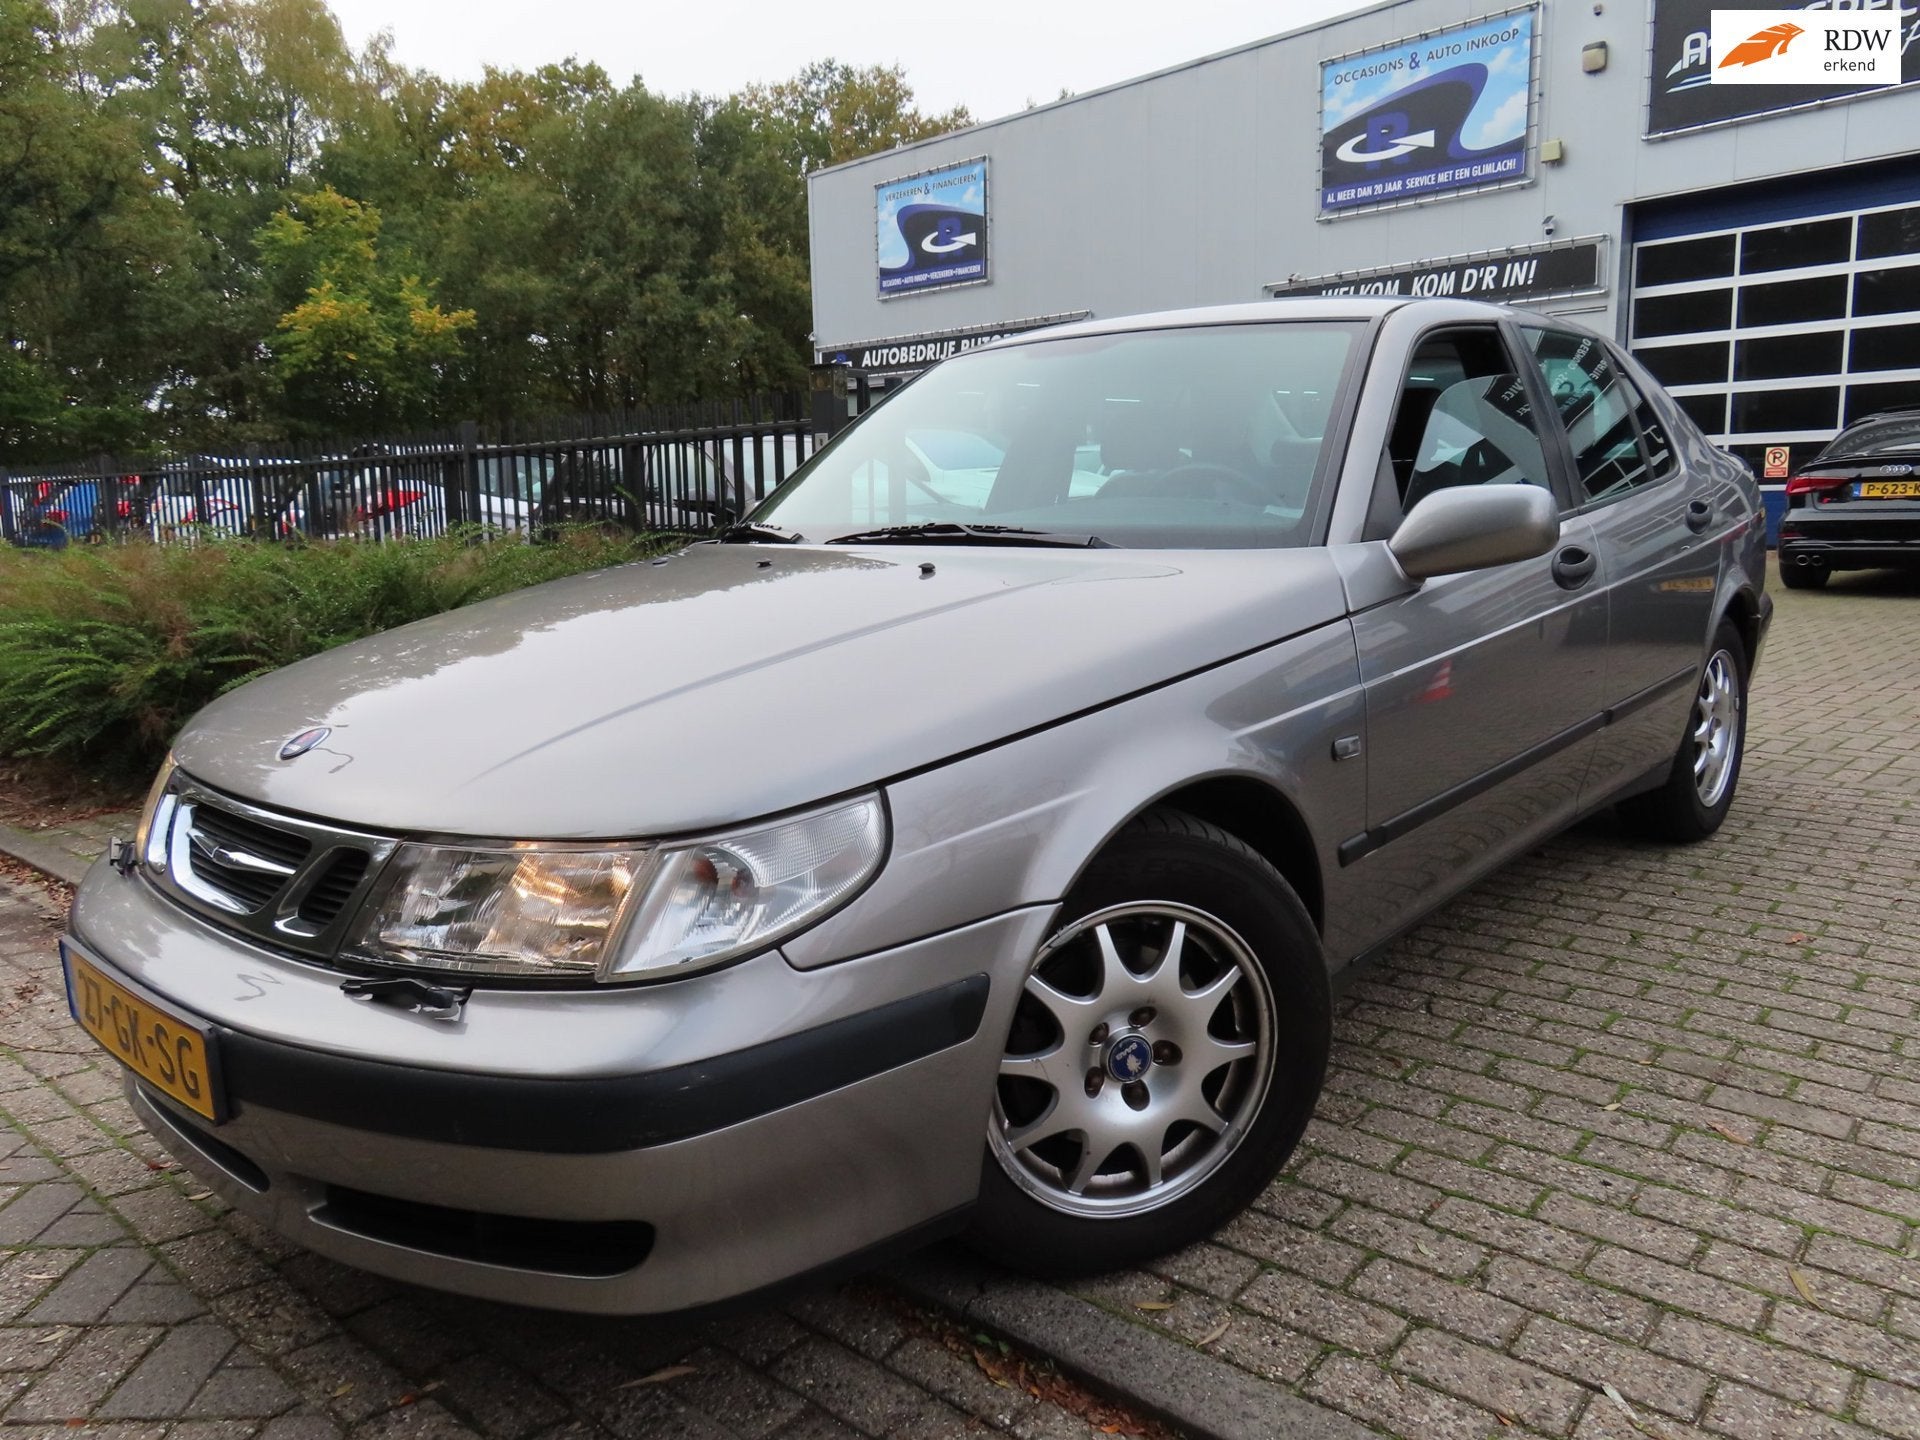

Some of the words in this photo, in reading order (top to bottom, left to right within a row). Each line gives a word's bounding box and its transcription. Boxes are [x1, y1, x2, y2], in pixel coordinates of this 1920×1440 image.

[1334, 57, 1404, 86] OCCASIONS
[1408, 51, 1421, 70] &
[1426, 43, 1462, 62] AUTO
[1466, 27, 1520, 52] INKOOP
[885, 186, 923, 202] VERZEKEREN
[923, 182, 931, 195] &
[931, 173, 977, 191] FINANCIEREN
[1326, 192, 1336, 204] AL
[1337, 189, 1356, 202] MEER
[1357, 186, 1373, 199] DAN
[1373, 183, 1383, 195] 20
[1383, 180, 1403, 194] JAAR
[1405, 173, 1436, 189] SERVICE
[1437, 170, 1454, 184] MET
[1455, 166, 1470, 179] EEN
[1471, 158, 1517, 177] GLIMLACH!
[1410, 271, 1456, 297] KOM
[1460, 265, 1499, 293] D'R
[1501, 259, 1538, 289] IN!
[861, 340, 956, 368] AUTOBEDRIJF
[77, 968, 201, 1101] 27-GK-SG
